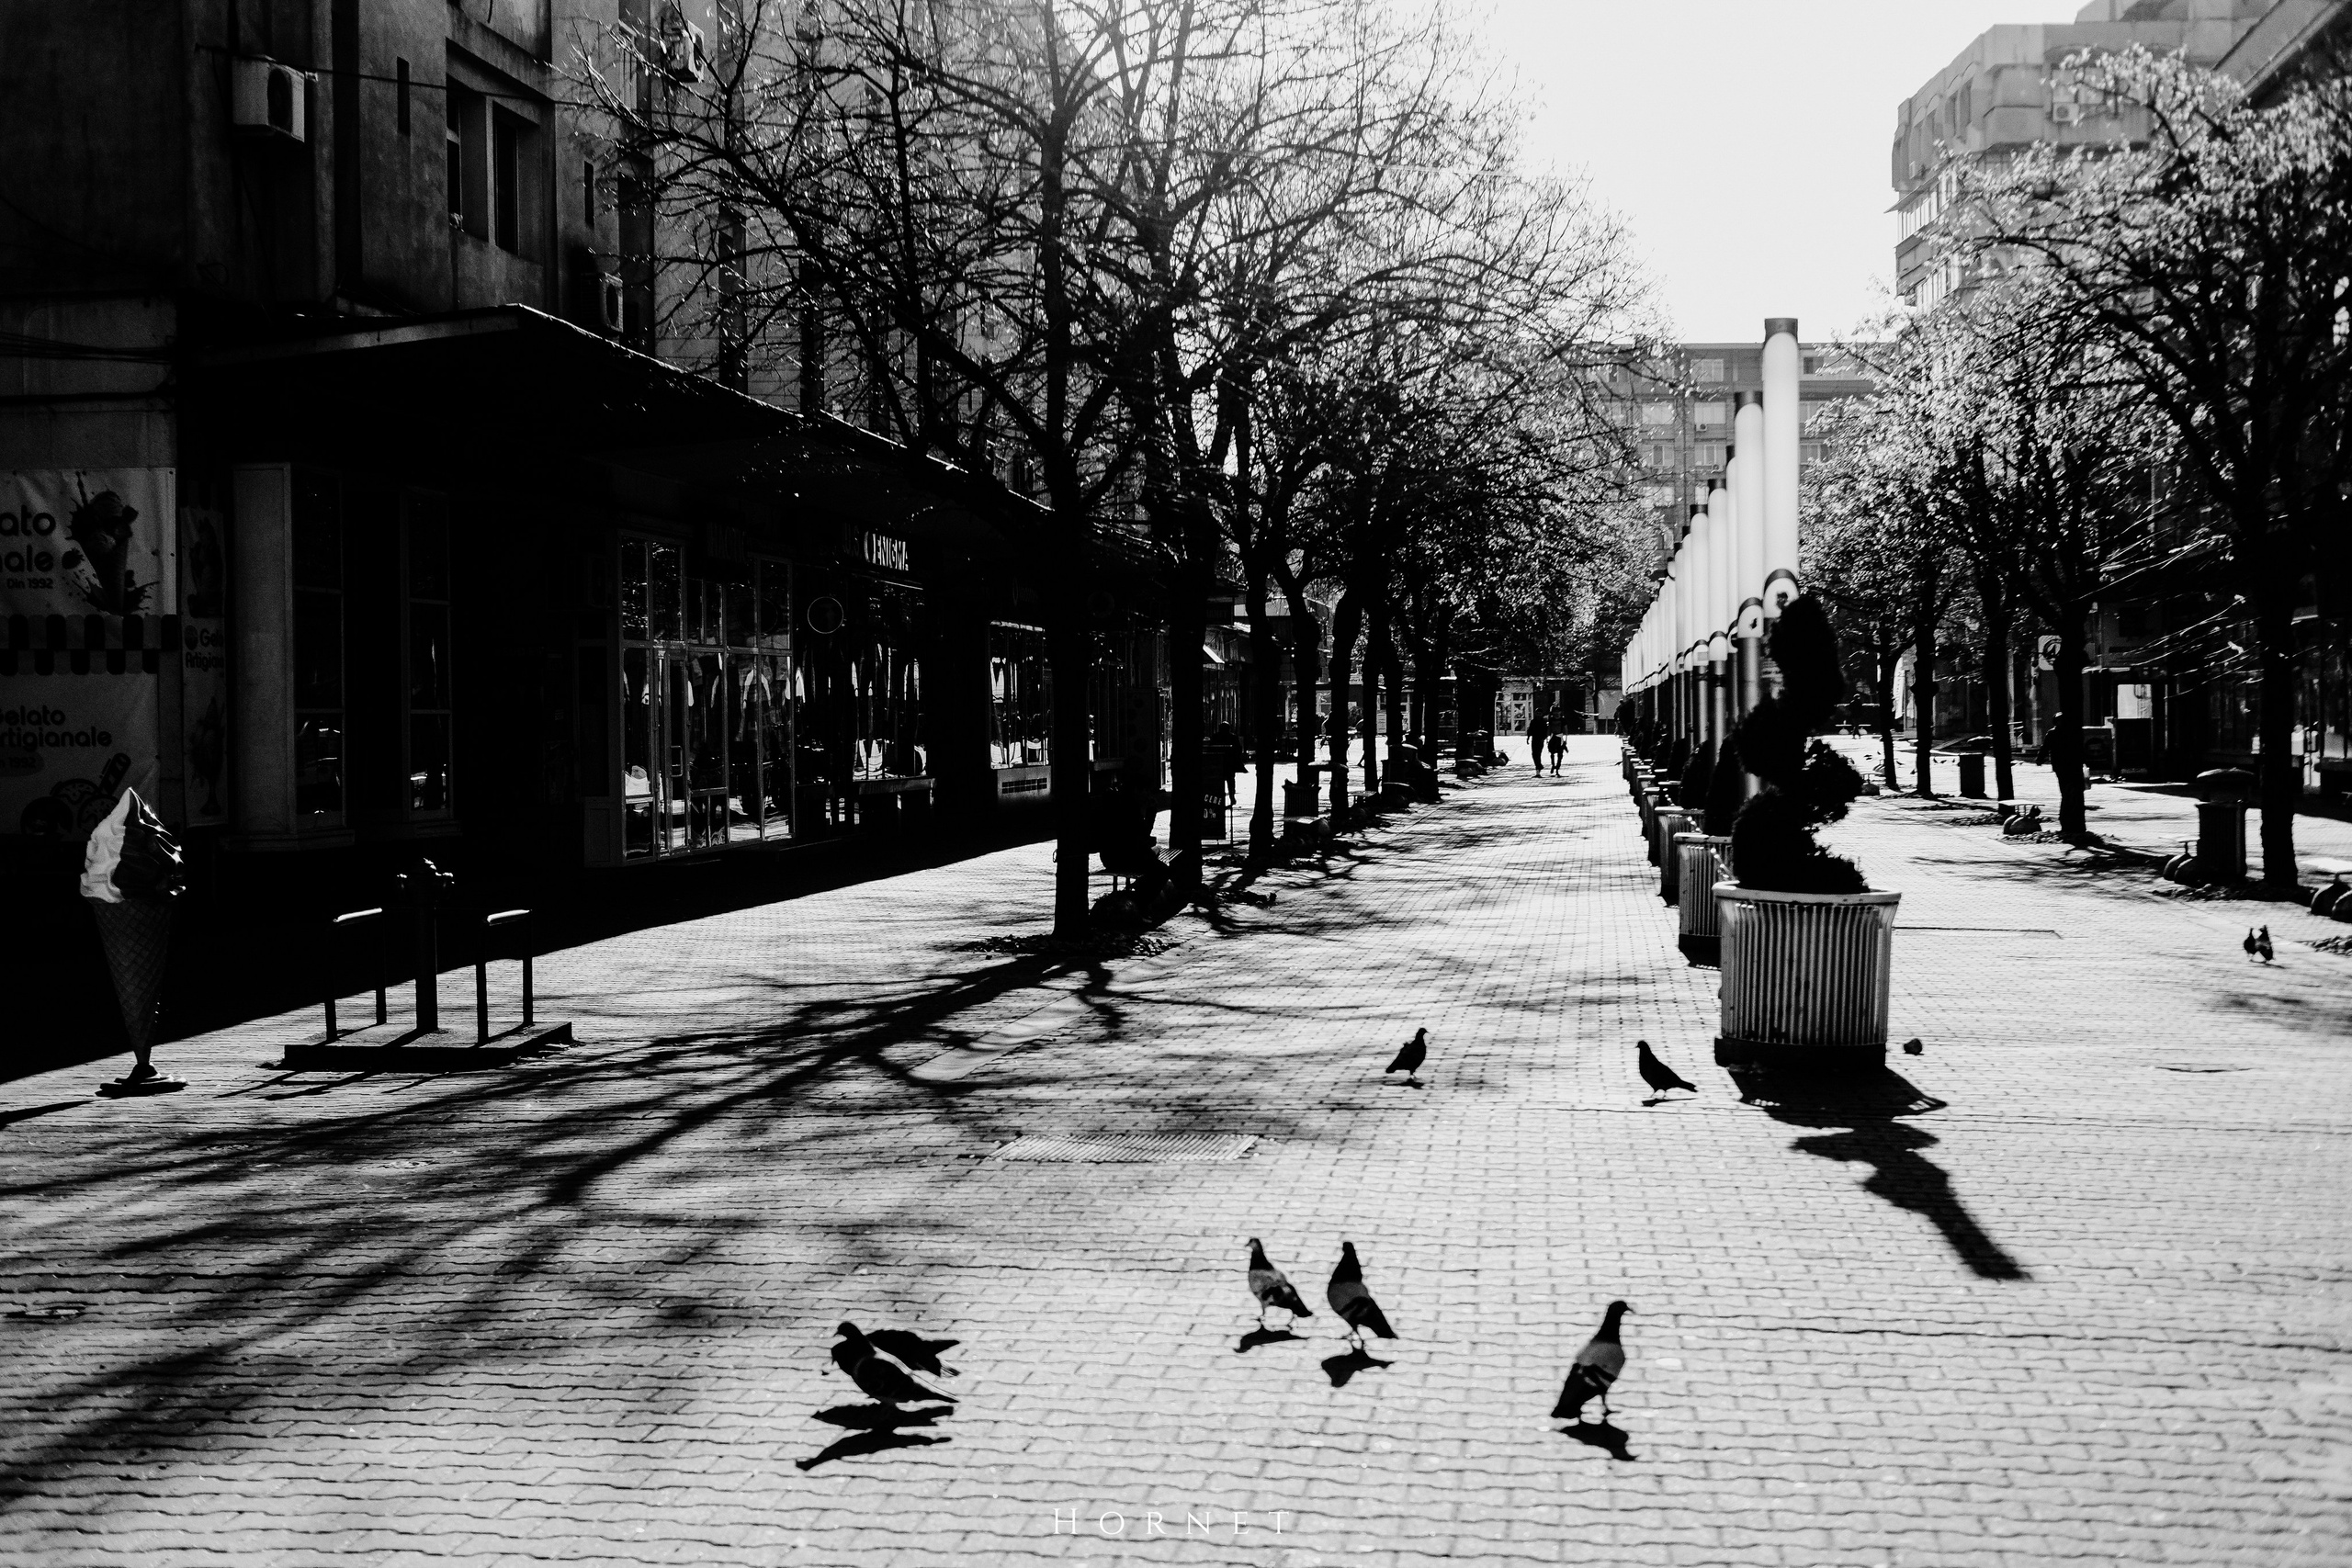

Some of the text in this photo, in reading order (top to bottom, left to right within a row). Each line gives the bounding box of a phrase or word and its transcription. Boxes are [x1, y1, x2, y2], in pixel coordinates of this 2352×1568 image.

[6, 578, 53, 589] Din 1992
[8, 757, 36, 769] 1992
